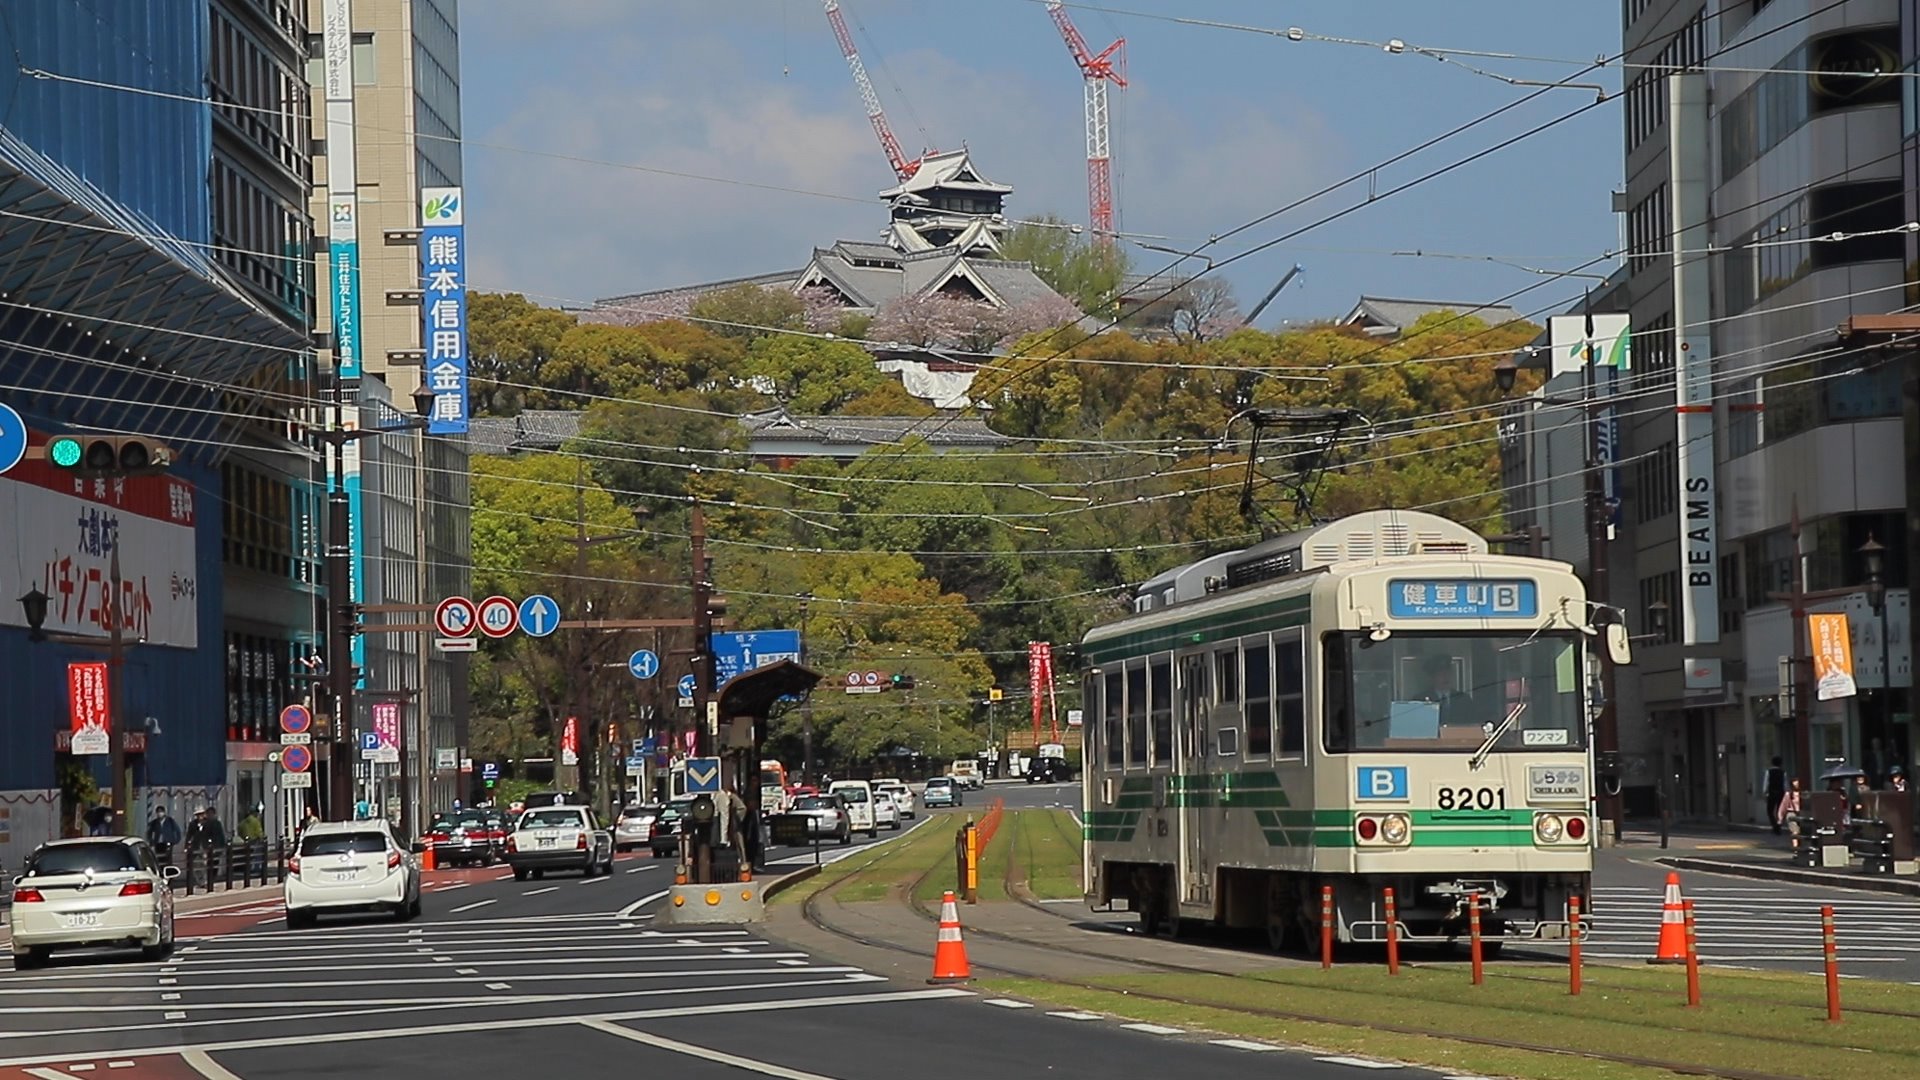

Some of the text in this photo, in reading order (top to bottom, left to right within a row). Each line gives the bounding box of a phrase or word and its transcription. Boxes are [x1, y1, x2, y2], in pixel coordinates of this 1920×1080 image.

[338, 253, 353, 368] 三井住友トラスト不動産
[428, 236, 462, 421] 熊本信用金庫
[1686, 476, 1712, 587] BEAMS
[45, 553, 153, 642] パチンコ&ロット
[1403, 583, 1489, 606] 健軍町
[1498, 587, 1514, 607] B
[487, 608, 508, 626] 40
[1415, 606, 1477, 614] Kengunmachi
[366, 734, 376, 748] P
[1527, 732, 1563, 742] ワンマン
[1371, 769, 1395, 796] B
[1532, 770, 1580, 785] しらかわ
[1438, 787, 1505, 811] 8201
